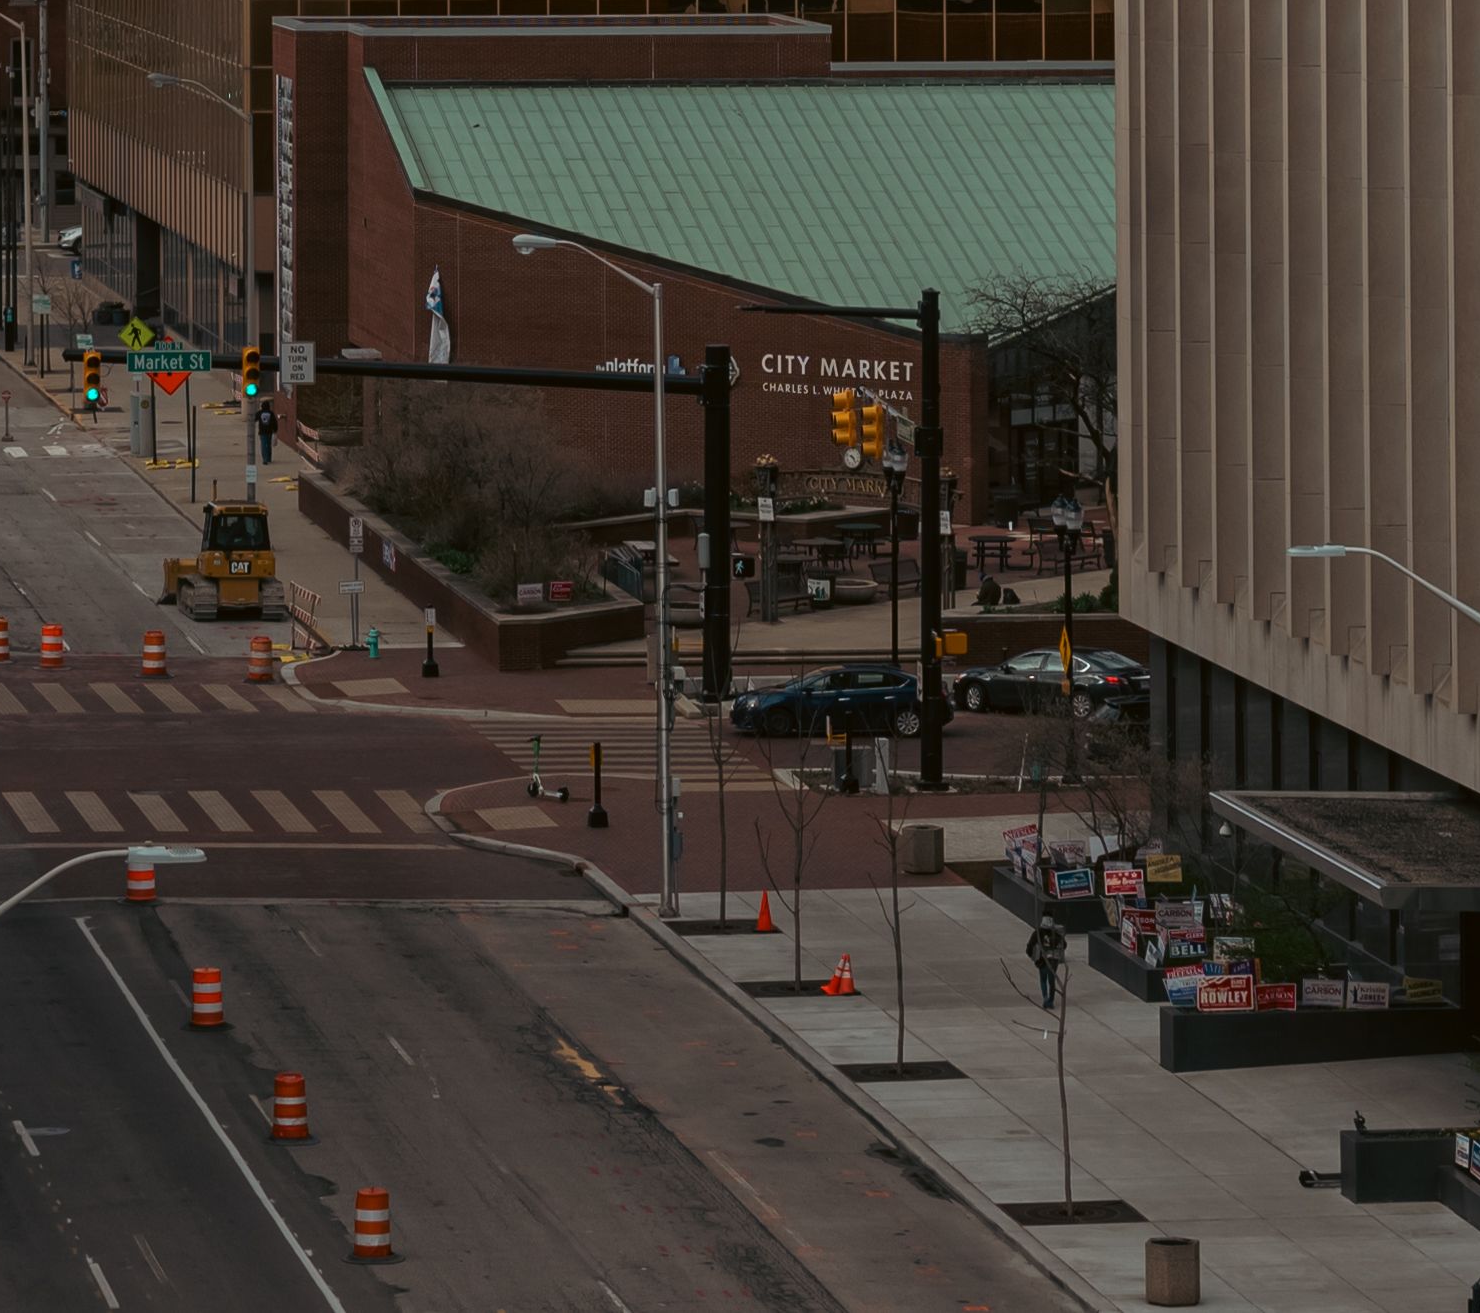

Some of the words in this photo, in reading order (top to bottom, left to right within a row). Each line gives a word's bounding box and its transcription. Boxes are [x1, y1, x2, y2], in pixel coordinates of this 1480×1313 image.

[290, 345, 305, 354] NO
[134, 354, 184, 370] Market
[189, 354, 204, 370] St
[288, 355, 308, 363] TURN
[292, 364, 304, 372] ON
[761, 353, 810, 375] CITY
[820, 357, 914, 382] MARKET
[290, 373, 306, 381] RED
[762, 382, 809, 395] CHARLES
[812, 386, 821, 395] L.
[878, 390, 913, 401] PLAZA
[806, 476, 839, 490] CITY
[230, 561, 250, 574] CAT
[1157, 909, 1194, 918] CARSON
[1171, 944, 1205, 956] BELL
[1304, 986, 1342, 994] CARSON
[1200, 990, 1248, 1004] ROWLEY
